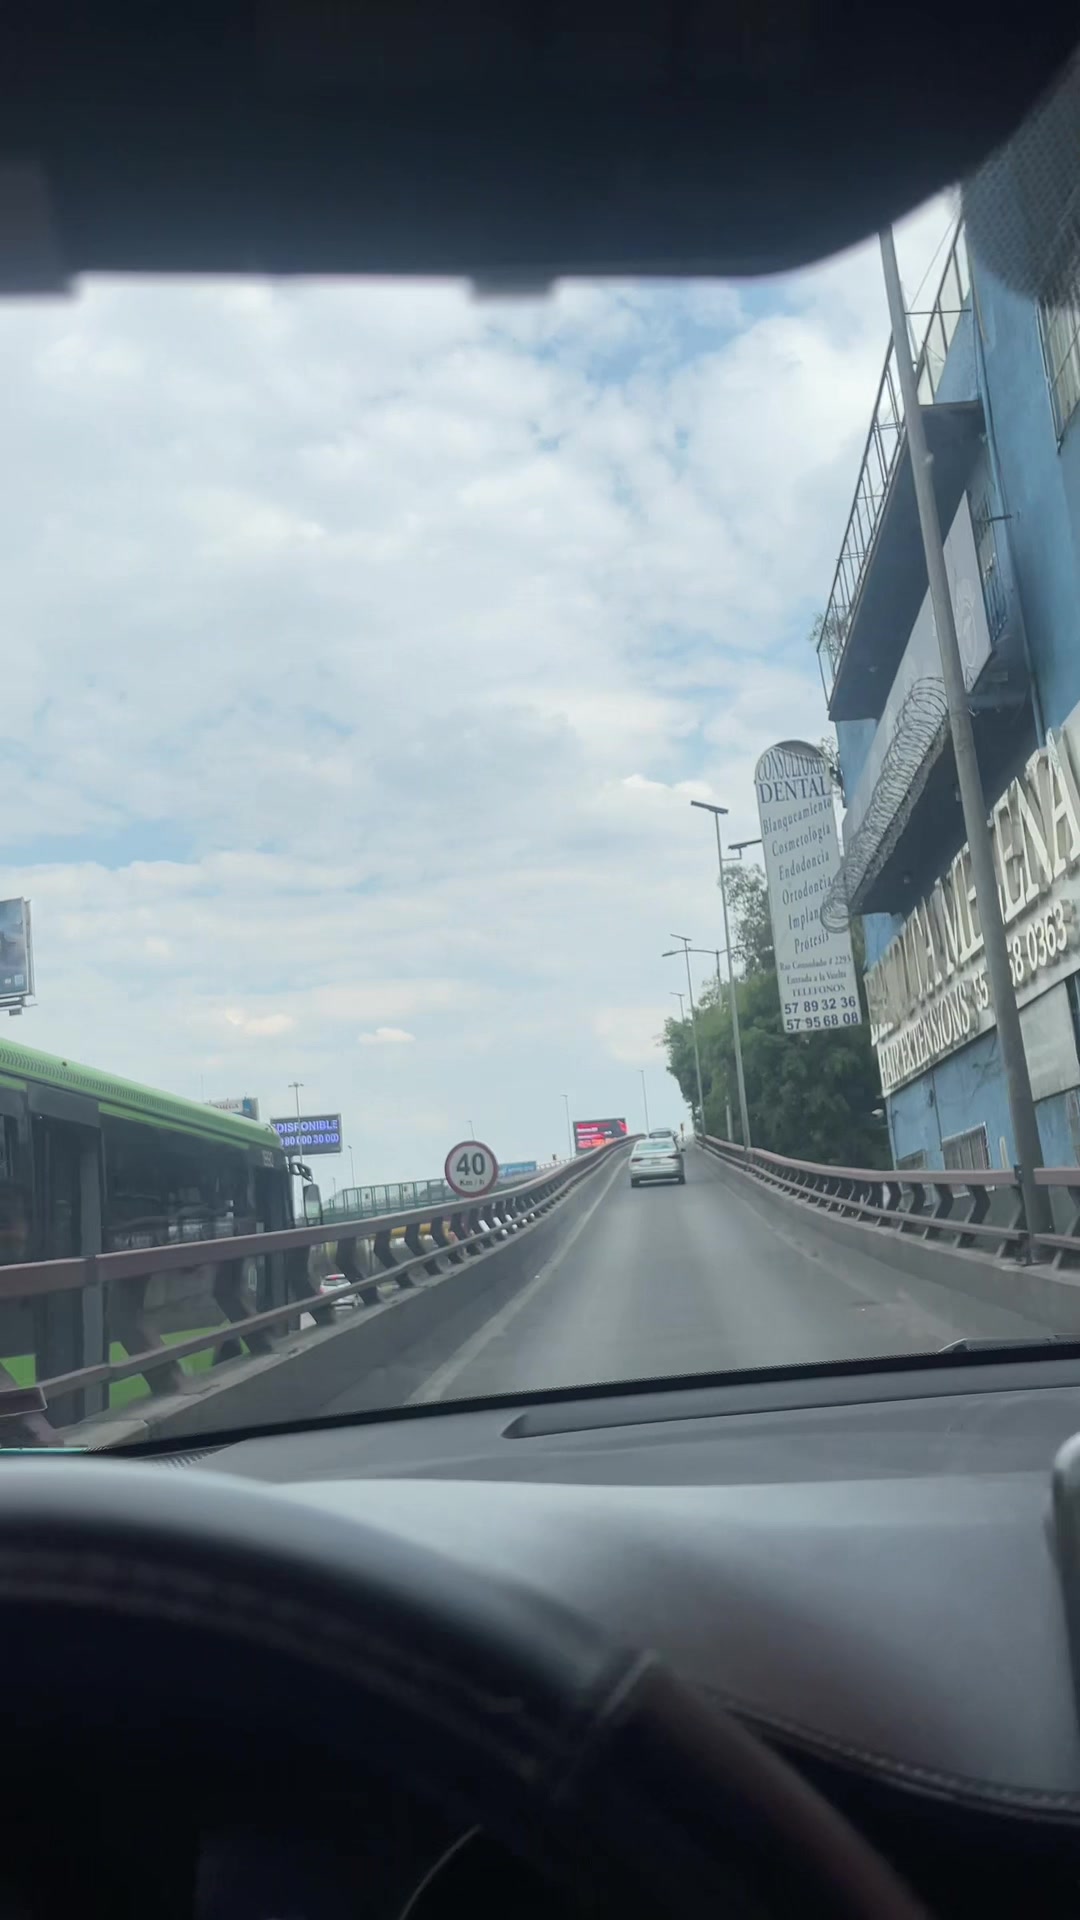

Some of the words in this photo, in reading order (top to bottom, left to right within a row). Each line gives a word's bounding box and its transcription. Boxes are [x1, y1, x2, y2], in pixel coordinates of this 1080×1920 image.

[758, 750, 827, 782] CONSULTORIO
[760, 776, 832, 804] DENTAL
[763, 797, 832, 836] Blanqueamiento
[779, 850, 830, 881] Endodoncia
[935, 726, 1080, 978] MEENA
[784, 1002, 800, 1016] 57
[803, 1000, 820, 1014] 89
[821, 998, 838, 1012] 32
[841, 995, 858, 1009] 36
[877, 1033, 900, 1089] HAIR
[899, 982, 971, 1076] EXTENSIONS
[971, 966, 989, 1013] 55
[1026, 900, 1067, 972] 0363
[786, 1018, 802, 1031] 57
[805, 1016, 822, 1030] 95
[823, 1014, 840, 1028] 68
[842, 1012, 860, 1026] 08
[456, 1152, 486, 1177] 40
